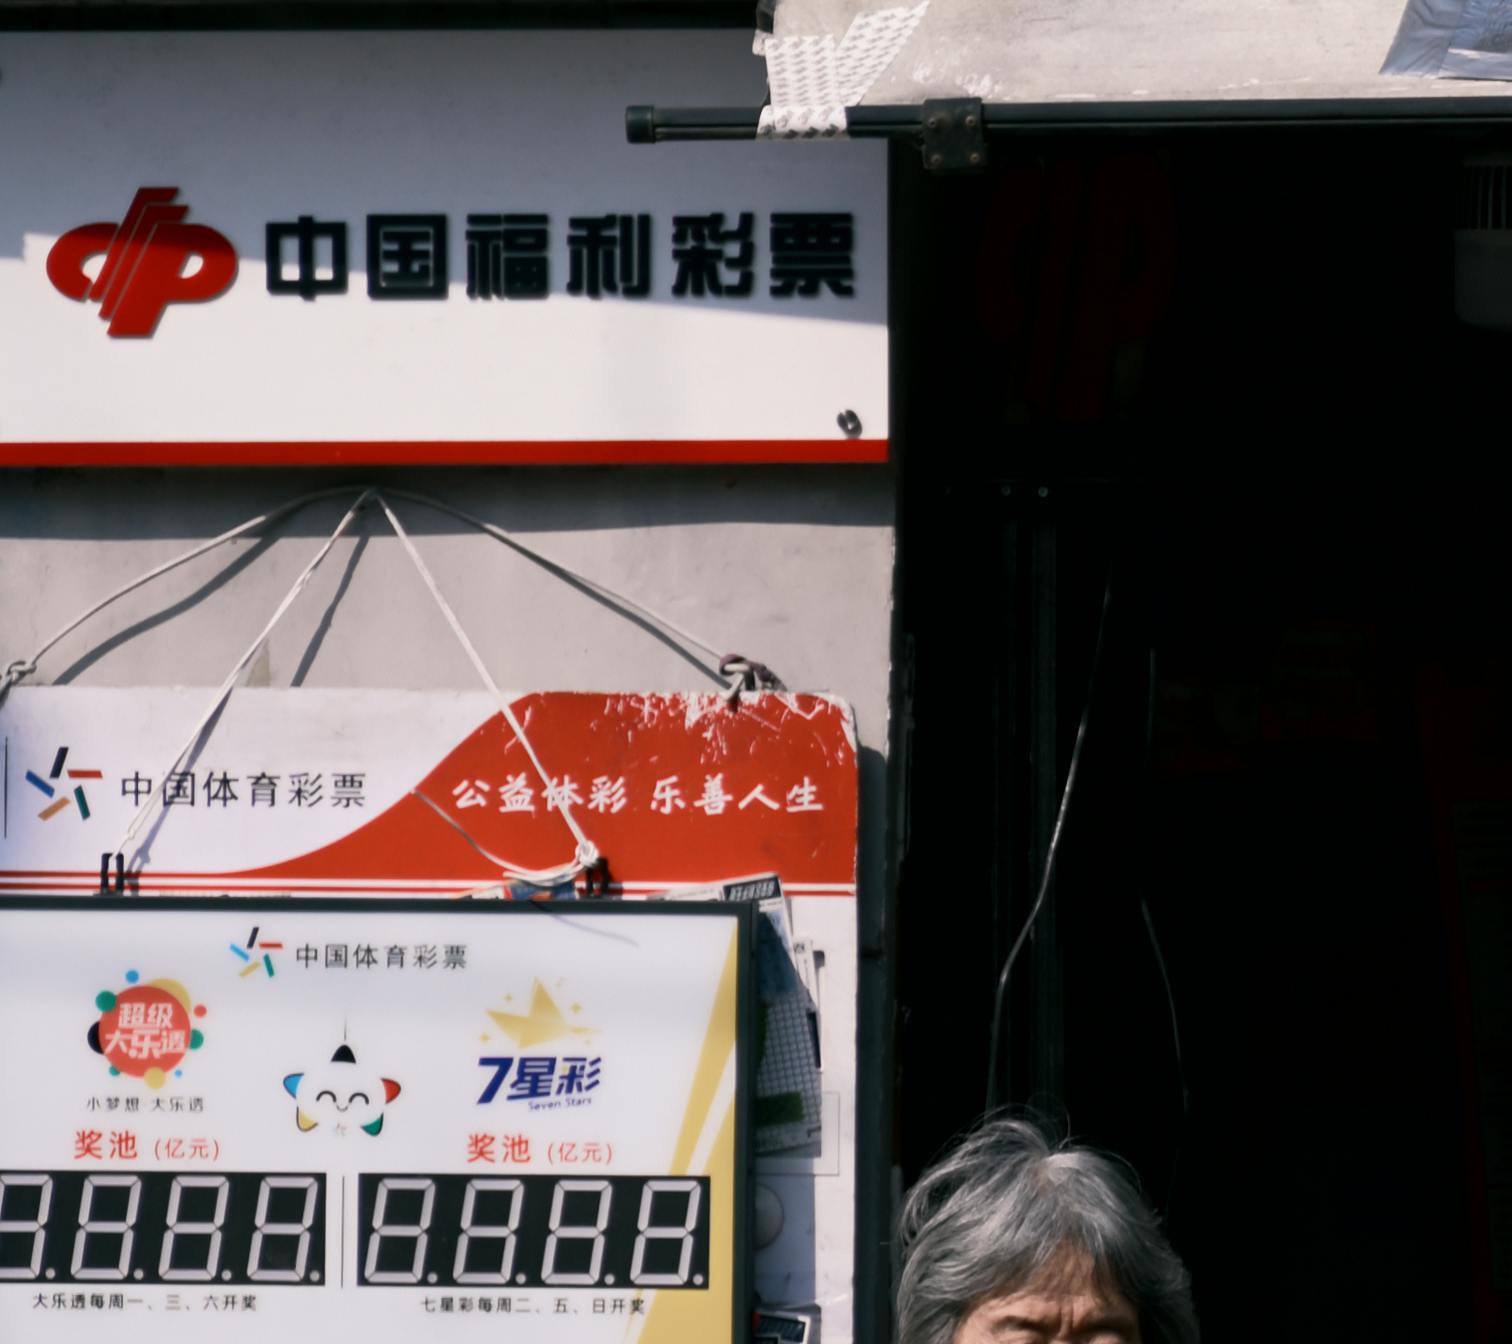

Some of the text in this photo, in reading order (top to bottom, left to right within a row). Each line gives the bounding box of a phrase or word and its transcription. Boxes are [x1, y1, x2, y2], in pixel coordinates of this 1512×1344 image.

[266, 213, 857, 300] 中国福利彩票
[121, 771, 824, 814] 中国体育彩票 公益体彩 乐善人生
[297, 943, 467, 970] 中国体育彩票
[118, 1002, 174, 1030] 超级
[104, 1029, 187, 1060] 大乐透
[476, 1056, 602, 1105] 7星彩
[74, 1129, 138, 1160] 奖池
[467, 1133, 532, 1164] 奖池
[33, 1293, 258, 1311] 大乐透每周一、三、六开奖
[420, 1296, 646, 1315] 七星彩每周二、五、日开奖
